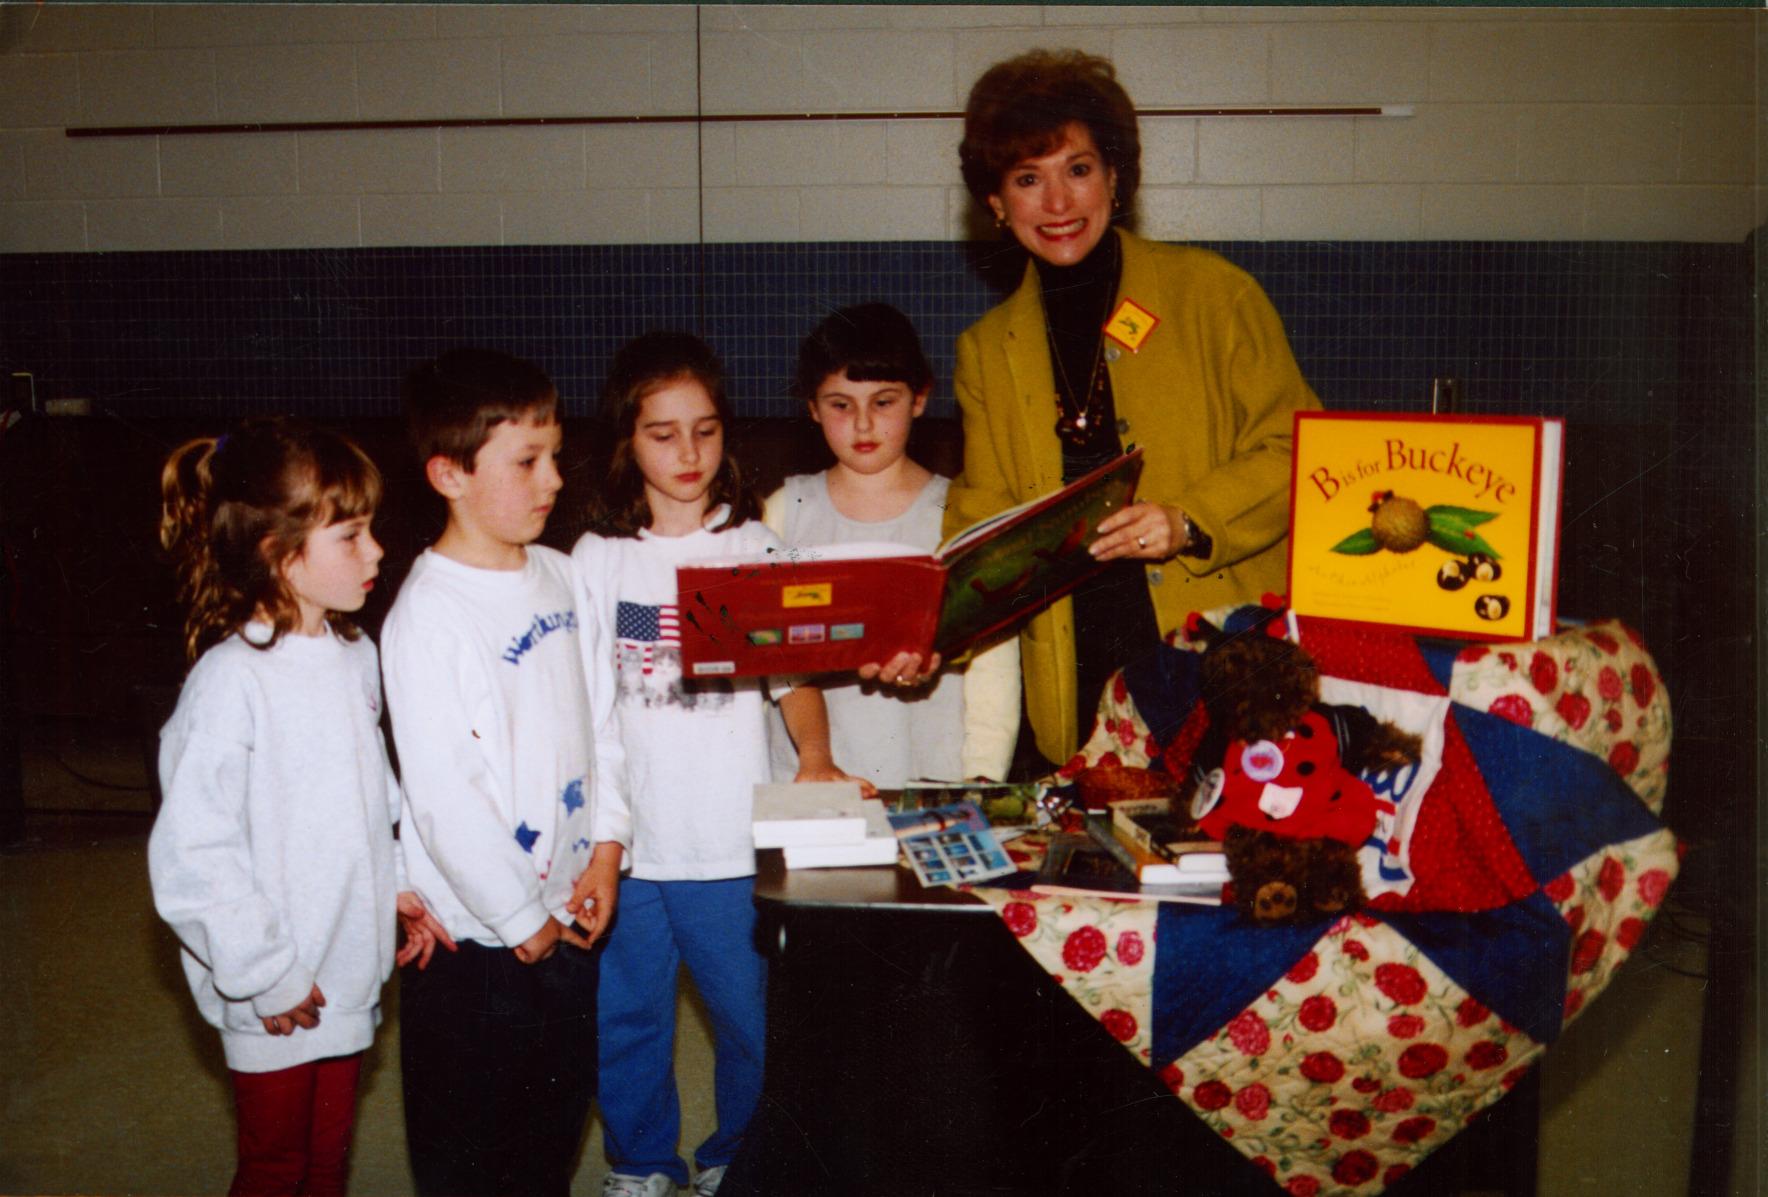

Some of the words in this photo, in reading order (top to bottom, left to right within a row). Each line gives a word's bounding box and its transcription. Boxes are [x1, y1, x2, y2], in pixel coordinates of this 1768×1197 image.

[1309, 466, 1341, 504] B
[1341, 471, 1356, 487] is
[1356, 459, 1381, 480] for
[1384, 438, 1516, 505] Buckeye
